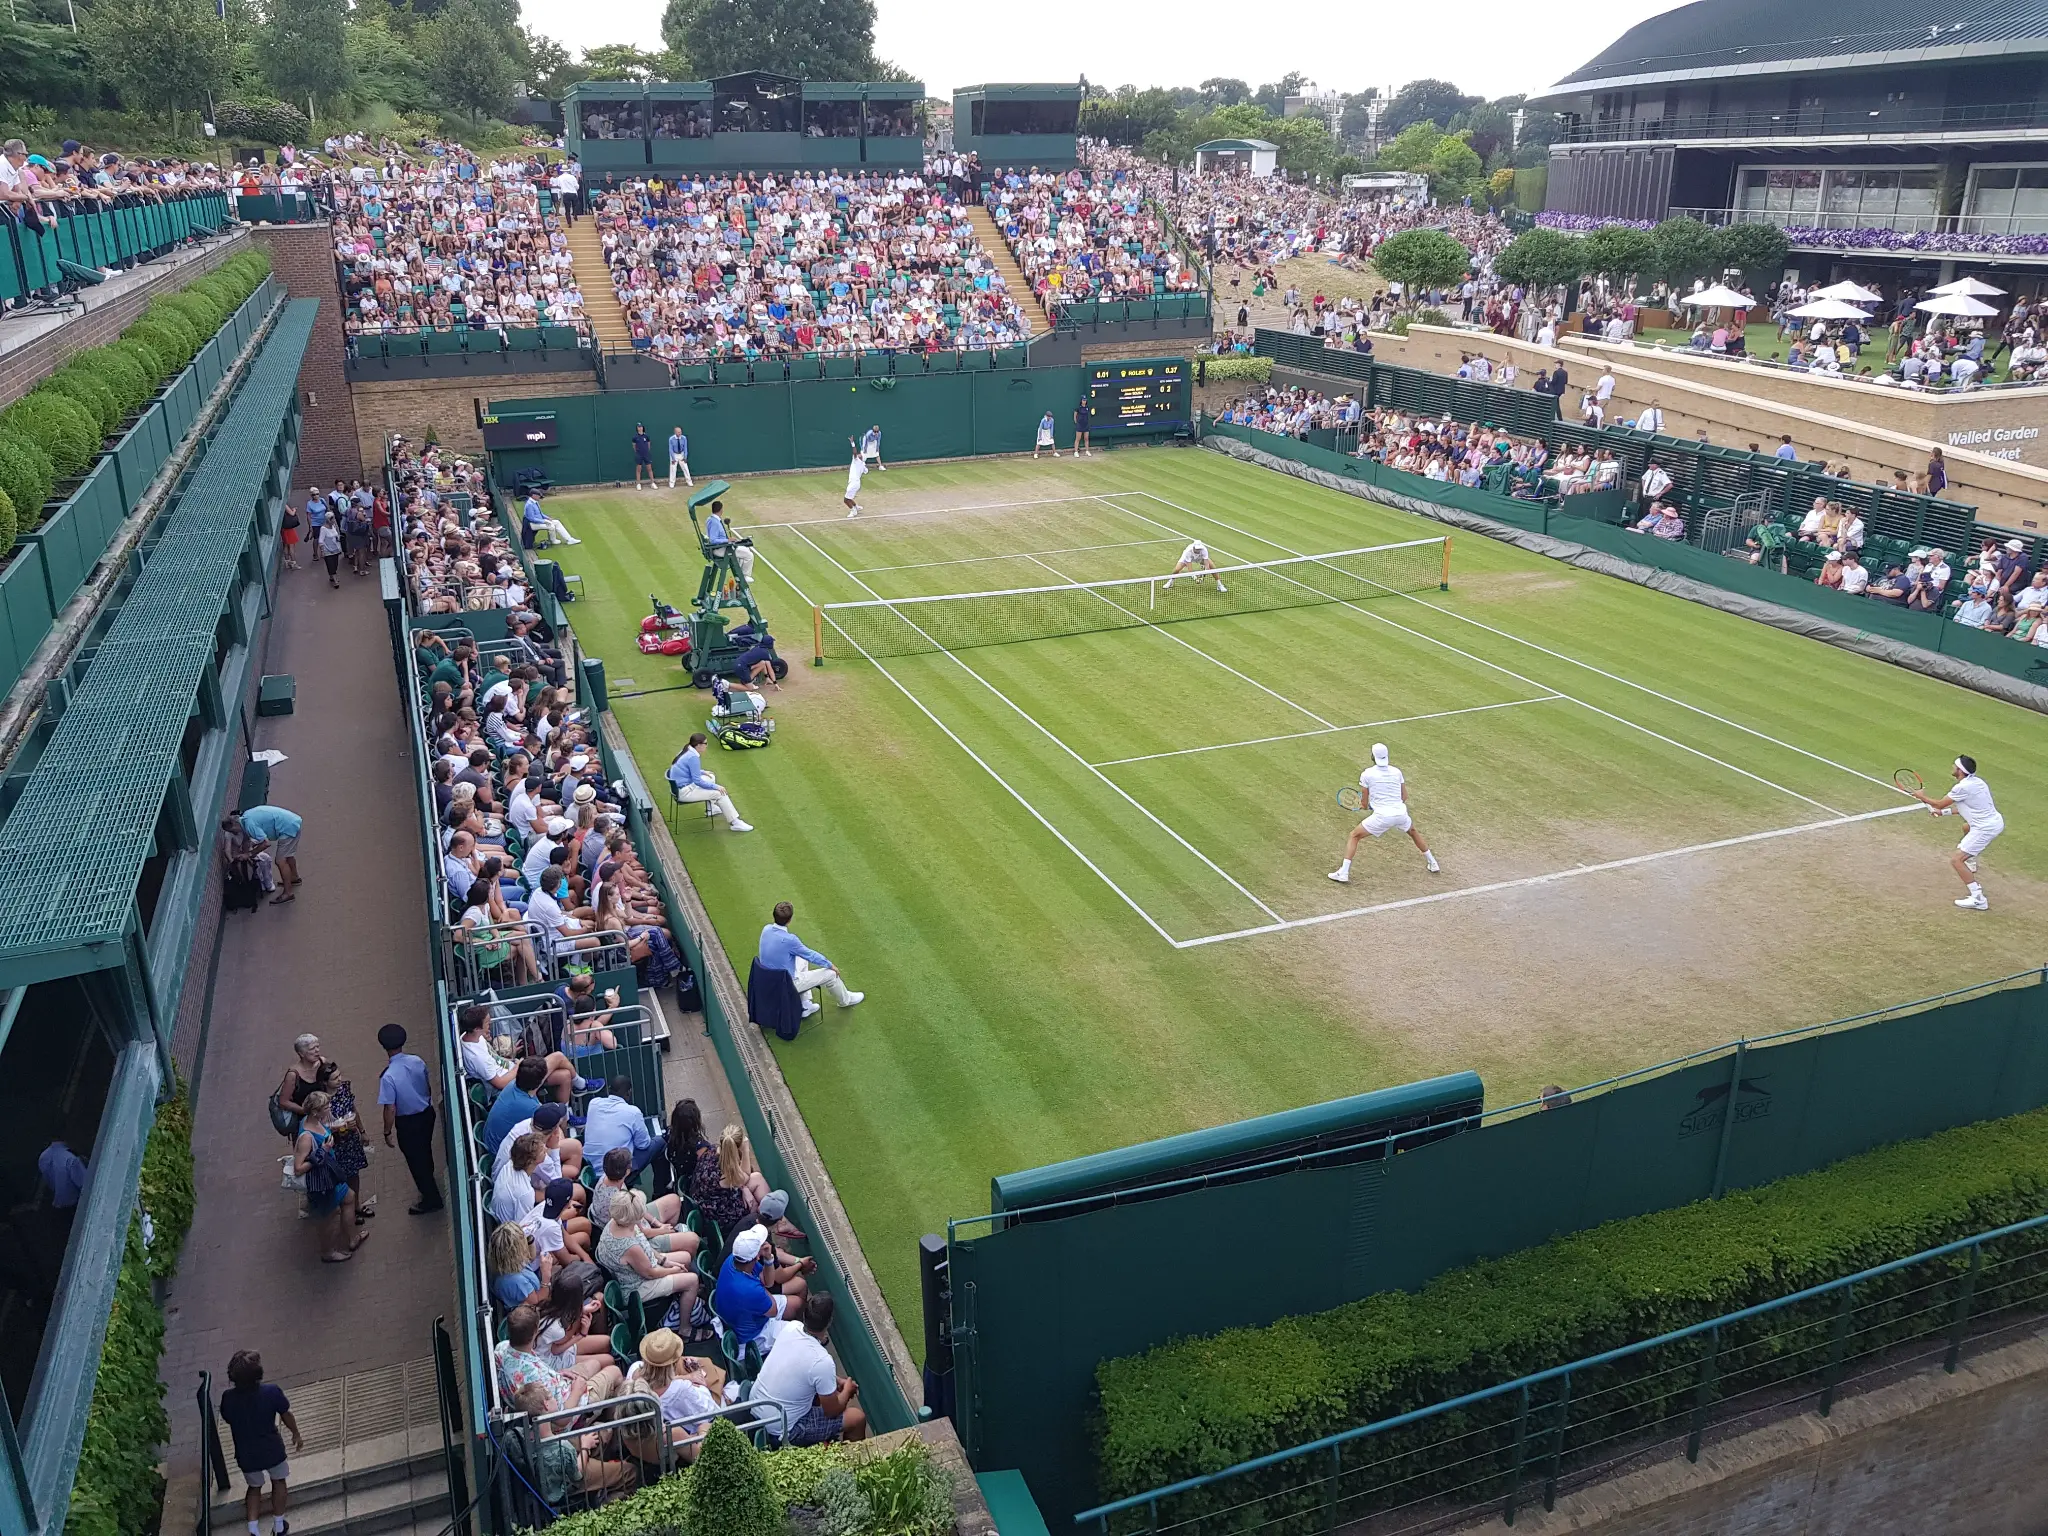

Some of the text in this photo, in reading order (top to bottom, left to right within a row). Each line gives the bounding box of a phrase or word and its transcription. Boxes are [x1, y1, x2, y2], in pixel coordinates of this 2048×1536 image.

[483, 416, 499, 424] IBM
[526, 431, 546, 441] mph
[1948, 426, 2039, 446] Walled Garden
[1678, 1100, 1773, 1136] Slazger
